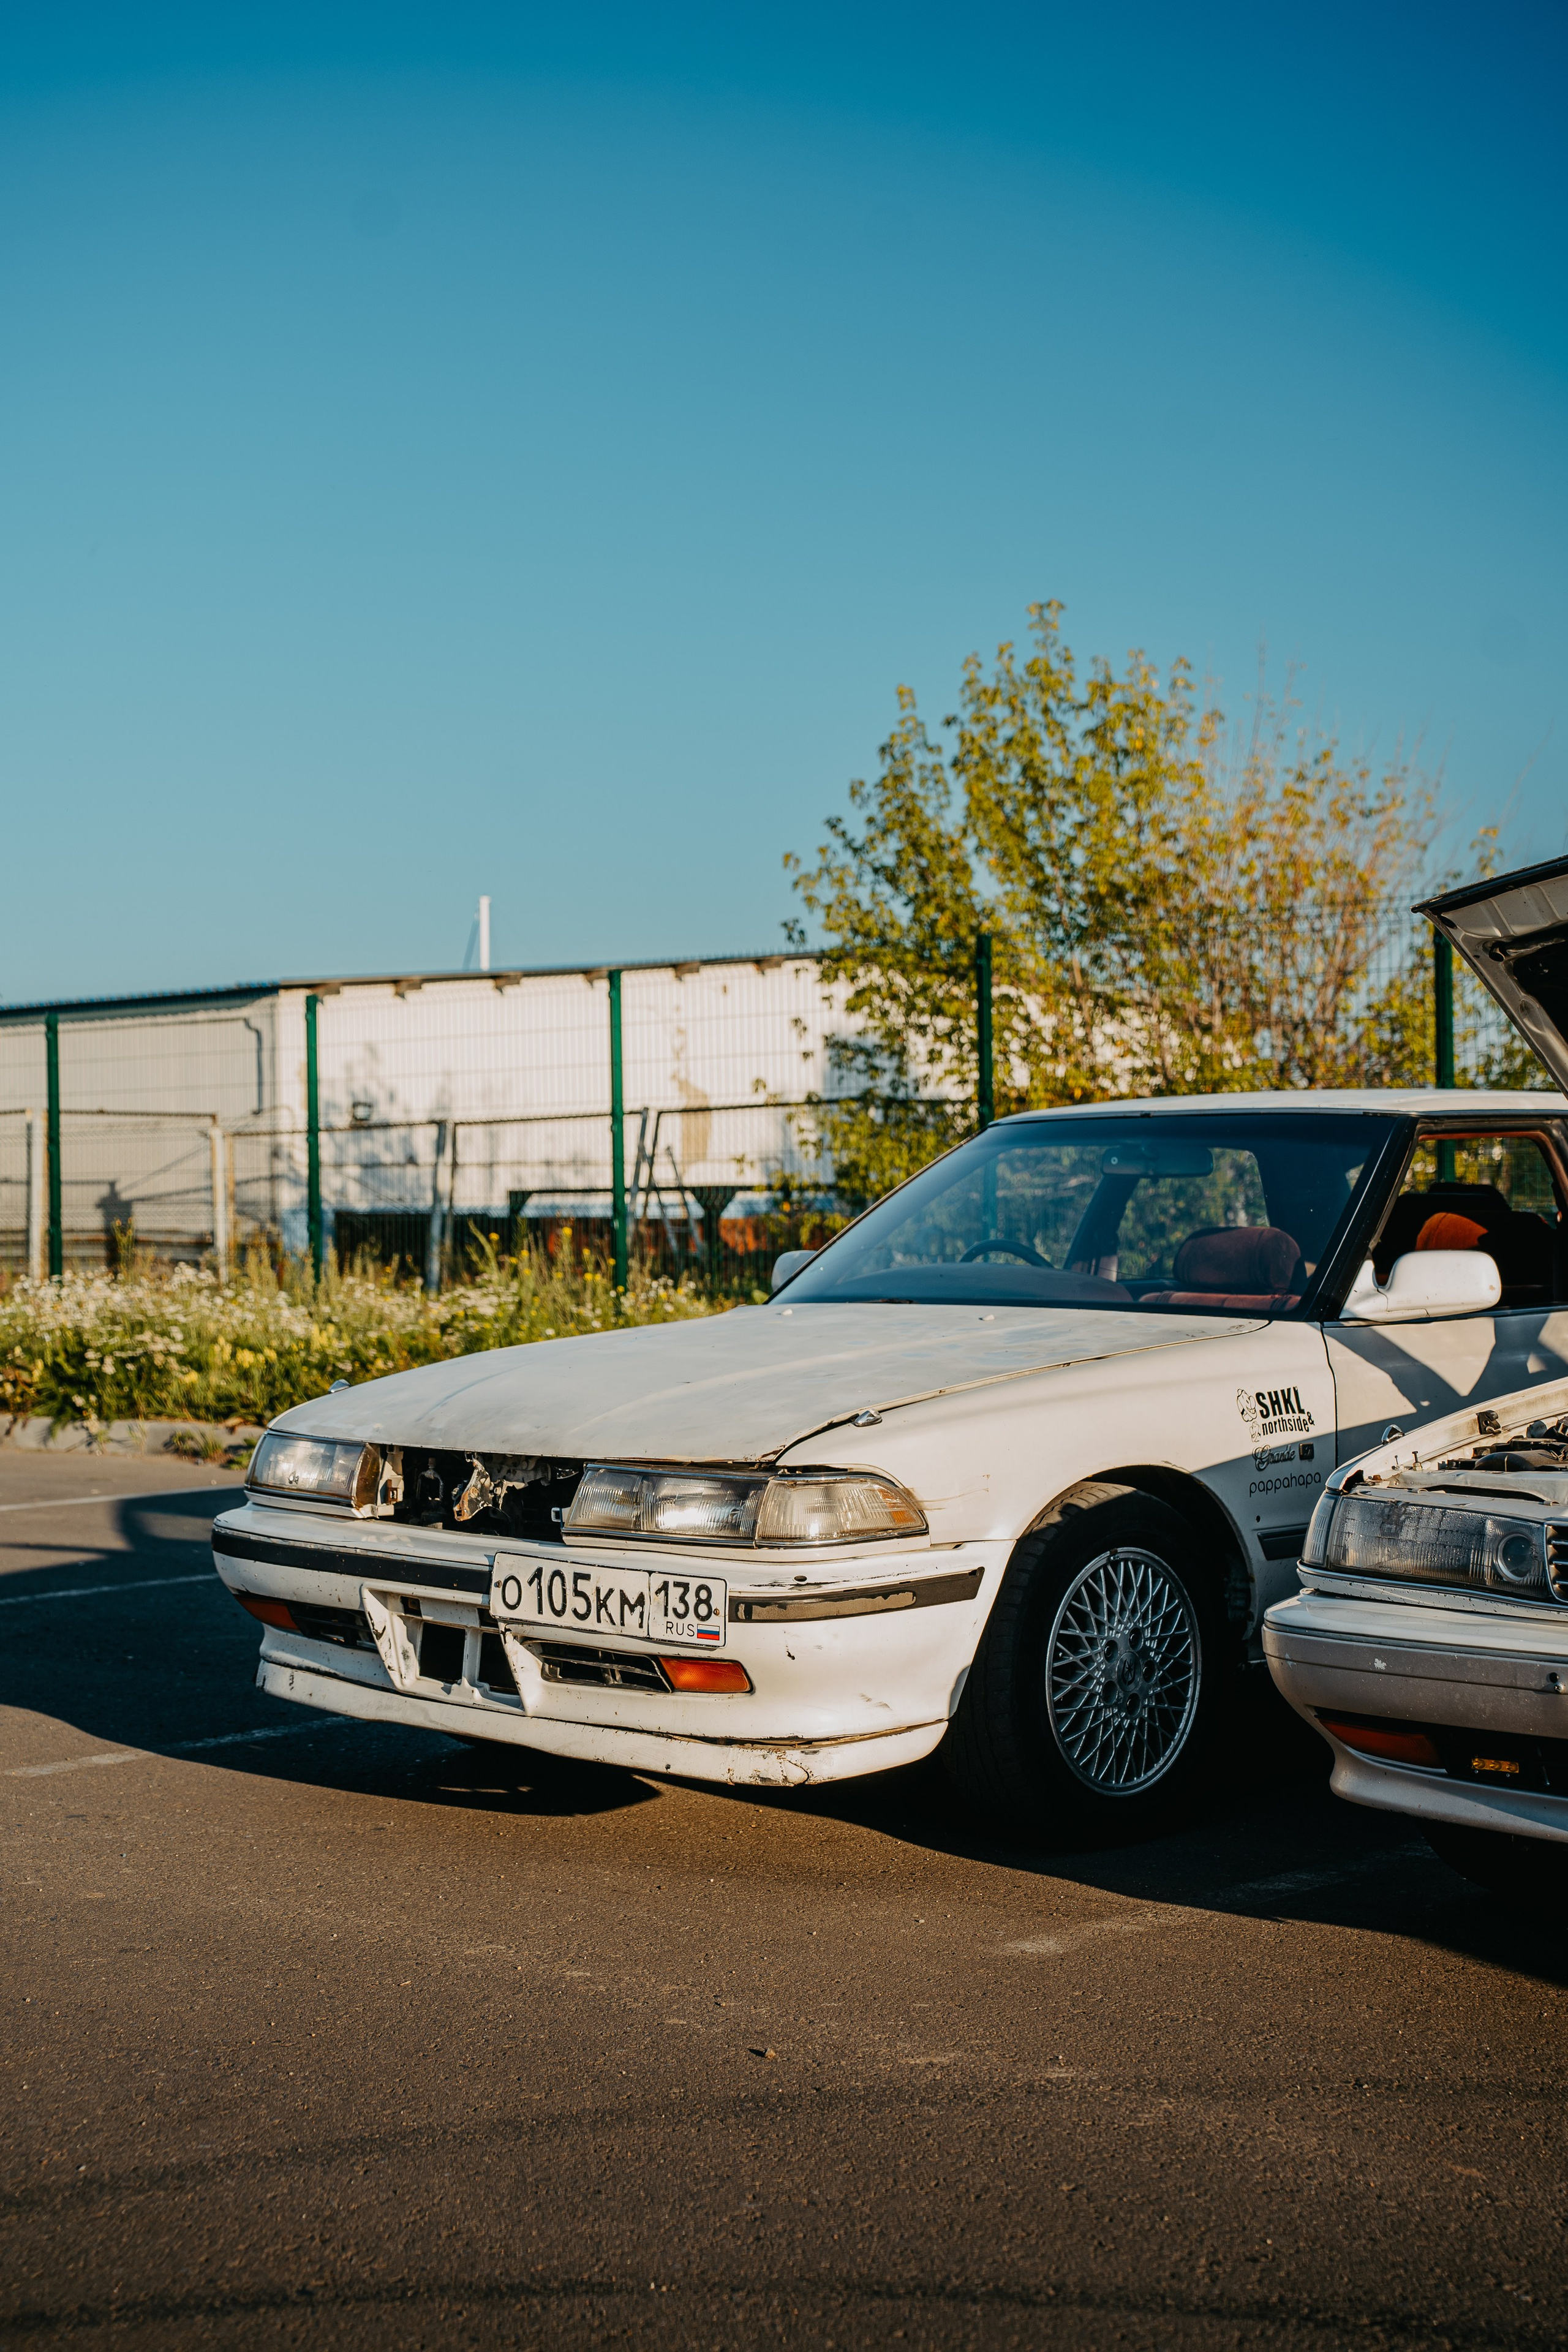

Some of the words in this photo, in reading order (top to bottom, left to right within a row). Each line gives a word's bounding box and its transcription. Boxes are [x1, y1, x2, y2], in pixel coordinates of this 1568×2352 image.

[1255, 1386, 1306, 1419] SHKL
[1250, 1472, 1321, 1498] pappahapa
[654, 1580, 713, 1622] 138
[666, 1621, 695, 1637] RUS
